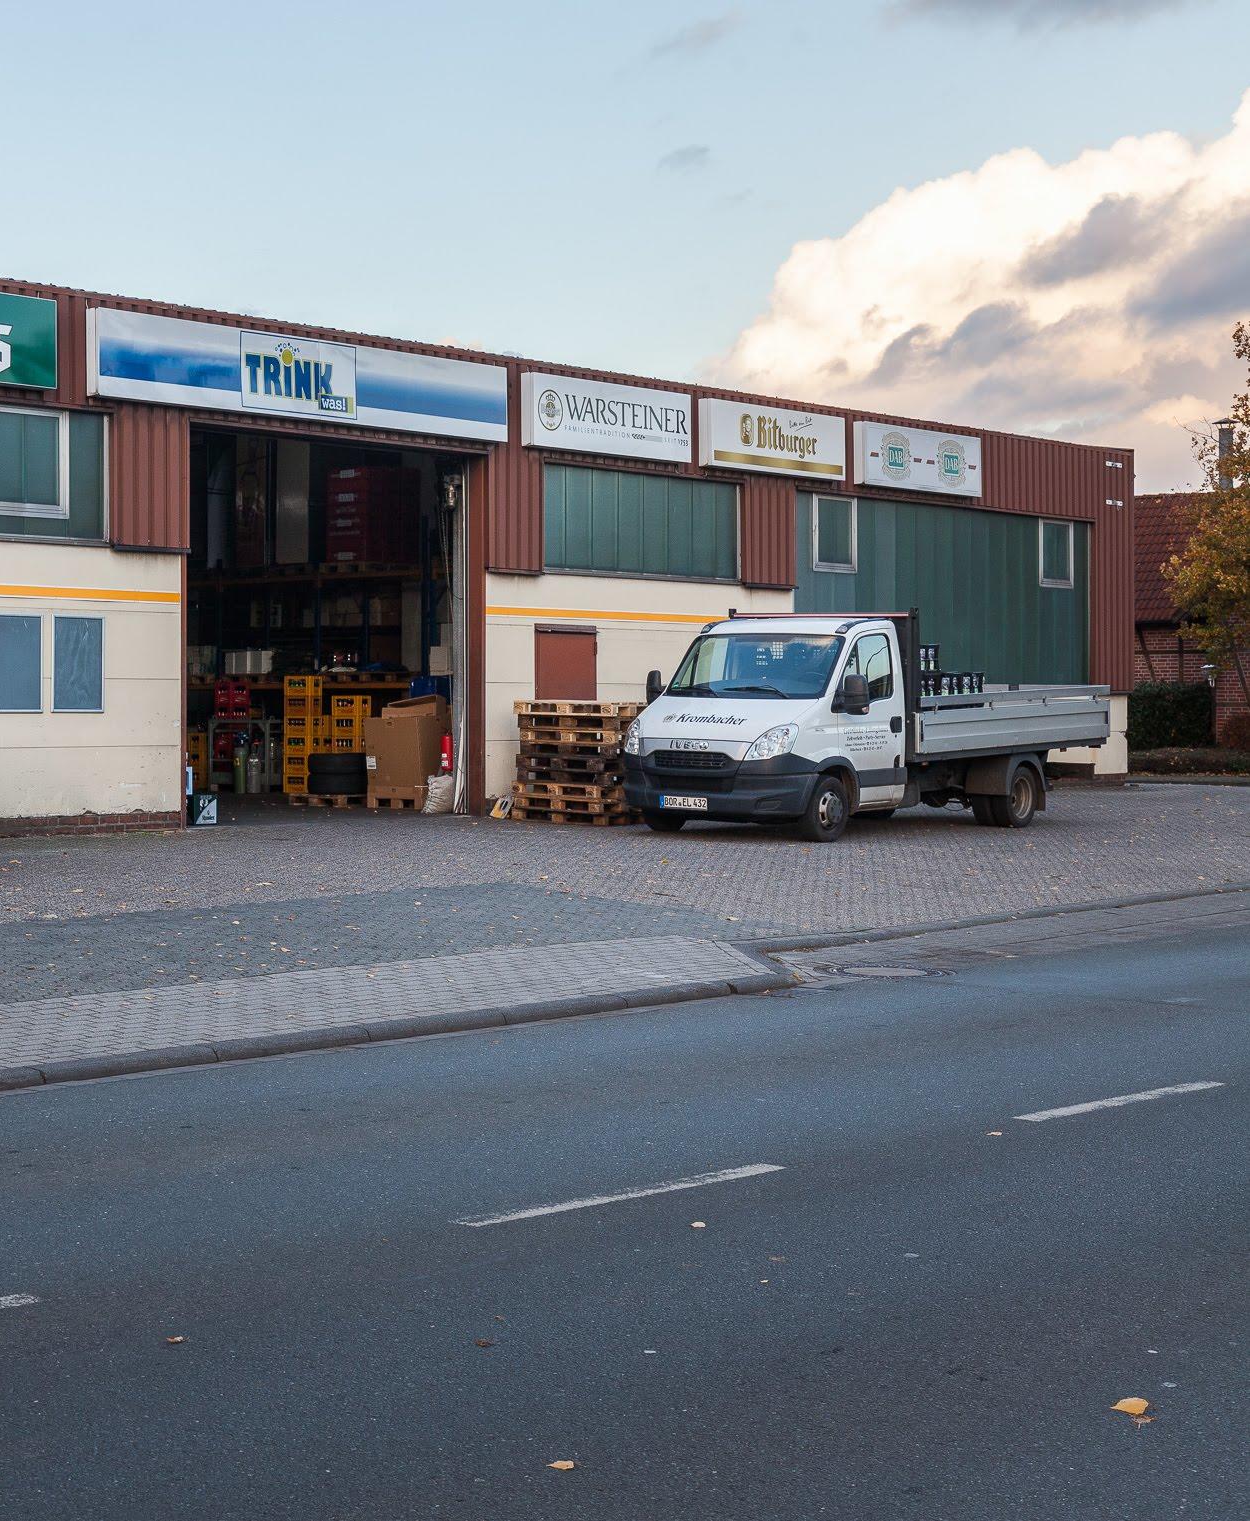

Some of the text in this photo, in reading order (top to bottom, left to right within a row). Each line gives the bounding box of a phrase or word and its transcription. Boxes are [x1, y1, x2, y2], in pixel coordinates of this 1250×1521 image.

[321, 398, 346, 411] was!
[564, 393, 688, 435] WARSTEINER
[756, 415, 818, 459] Bitburger
[889, 449, 903, 464] DAB
[945, 456, 959, 471] DAB
[676, 713, 748, 726] Krombacher
